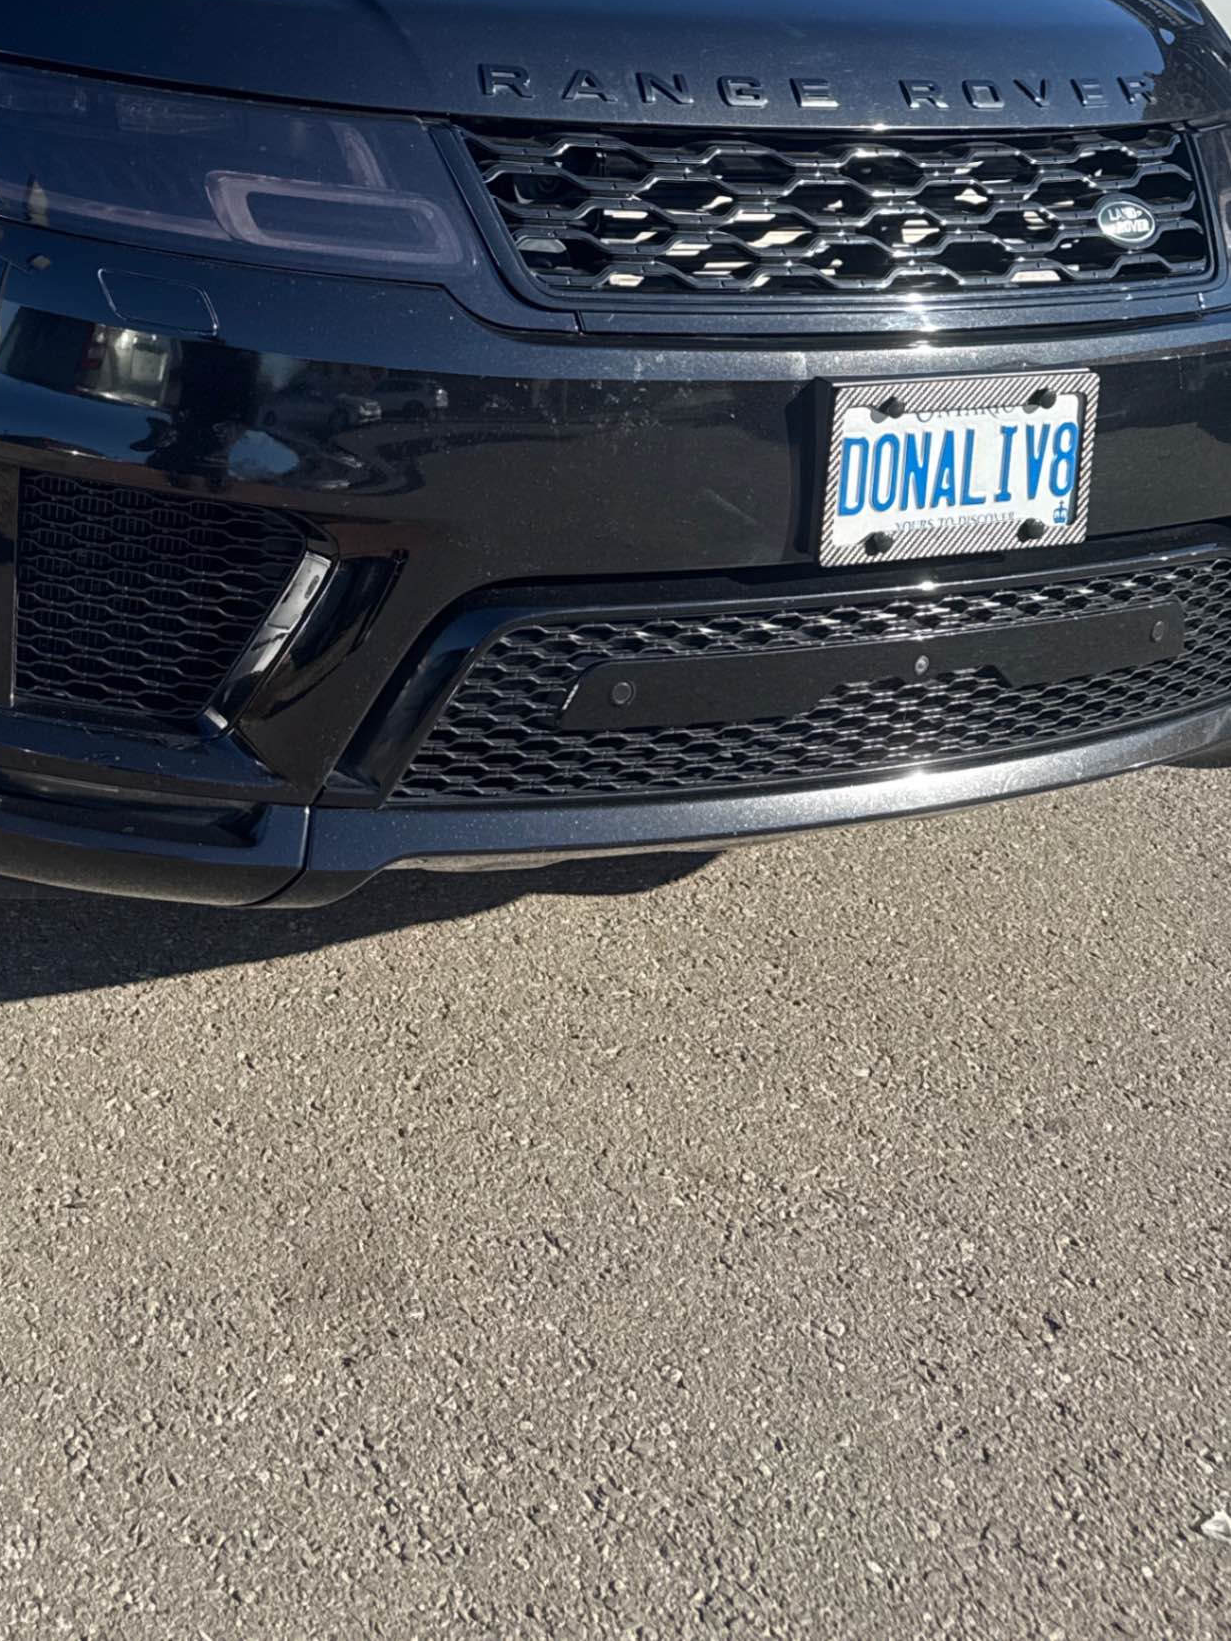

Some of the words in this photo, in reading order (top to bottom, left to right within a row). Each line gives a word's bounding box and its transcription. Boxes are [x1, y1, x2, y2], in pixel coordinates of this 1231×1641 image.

[477, 62, 840, 109] RANGE
[898, 73, 1158, 111] ROVER
[837, 421, 1079, 517] DONALIV8
